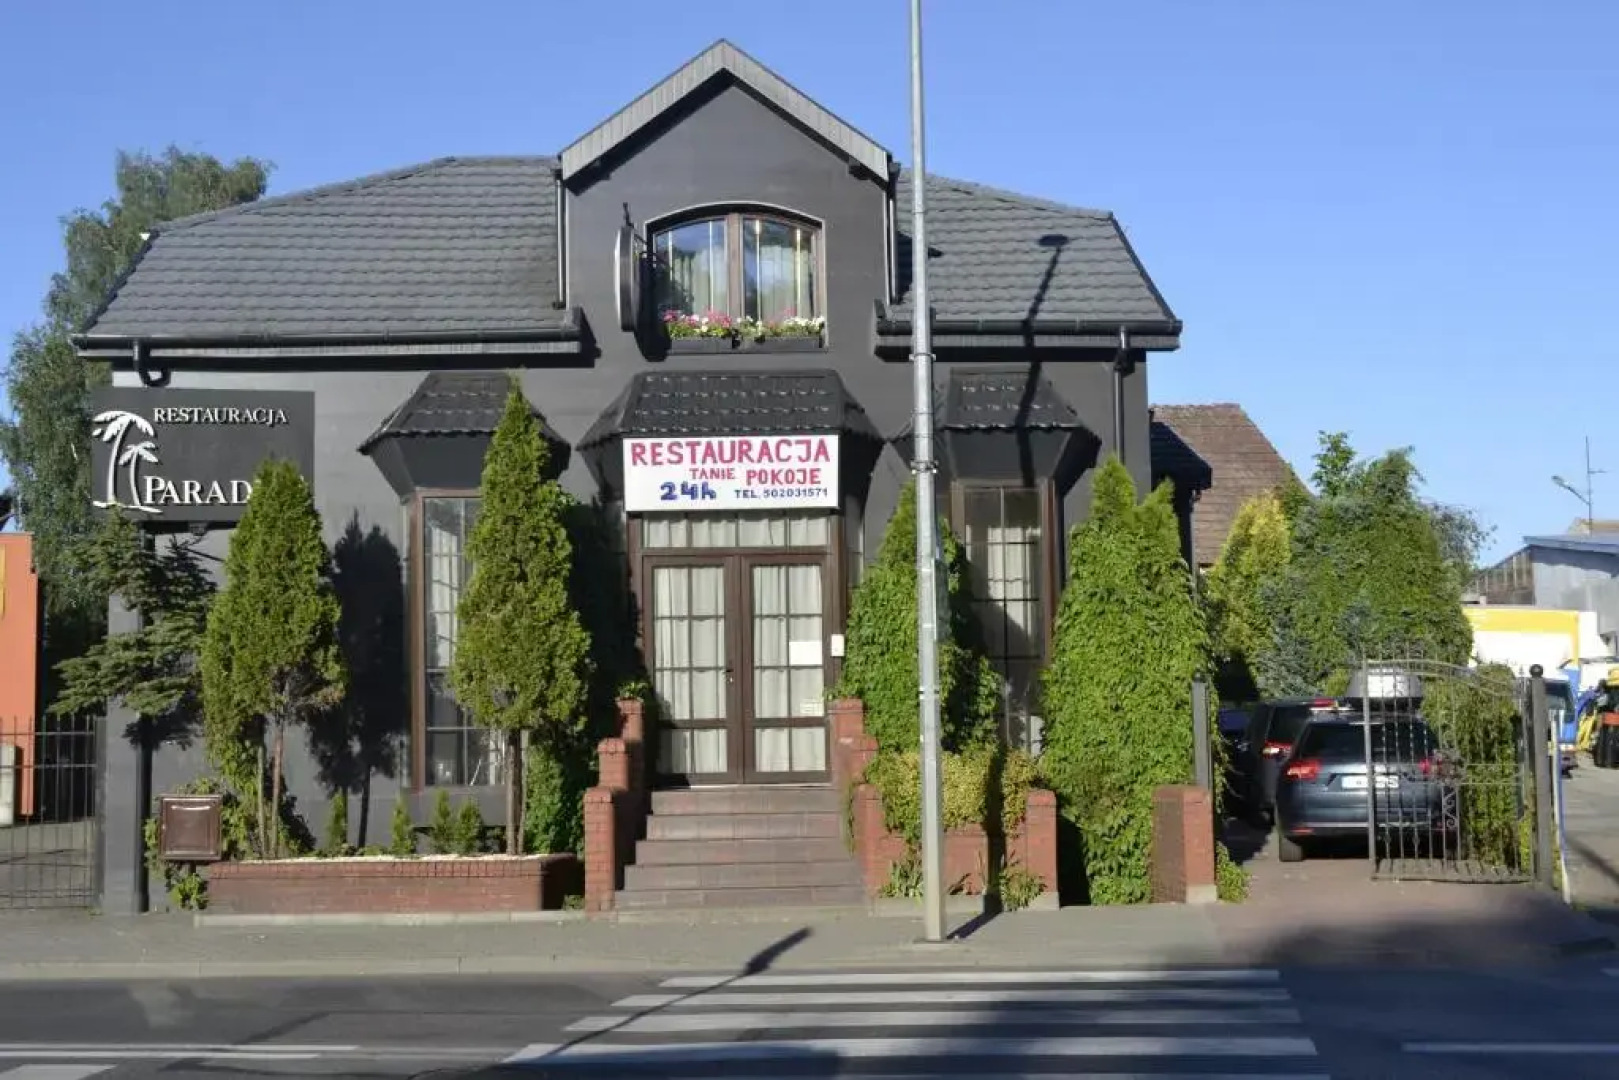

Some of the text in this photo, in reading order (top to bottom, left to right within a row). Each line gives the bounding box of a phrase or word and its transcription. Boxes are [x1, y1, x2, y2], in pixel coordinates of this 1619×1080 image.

[153, 407, 287, 427] RESTAURACJA
[630, 439, 830, 466] RESTAURACJA
[689, 468, 821, 486] TANIE POKOJE
[143, 475, 253, 505] PARAD
[660, 481, 717, 501] 24h
